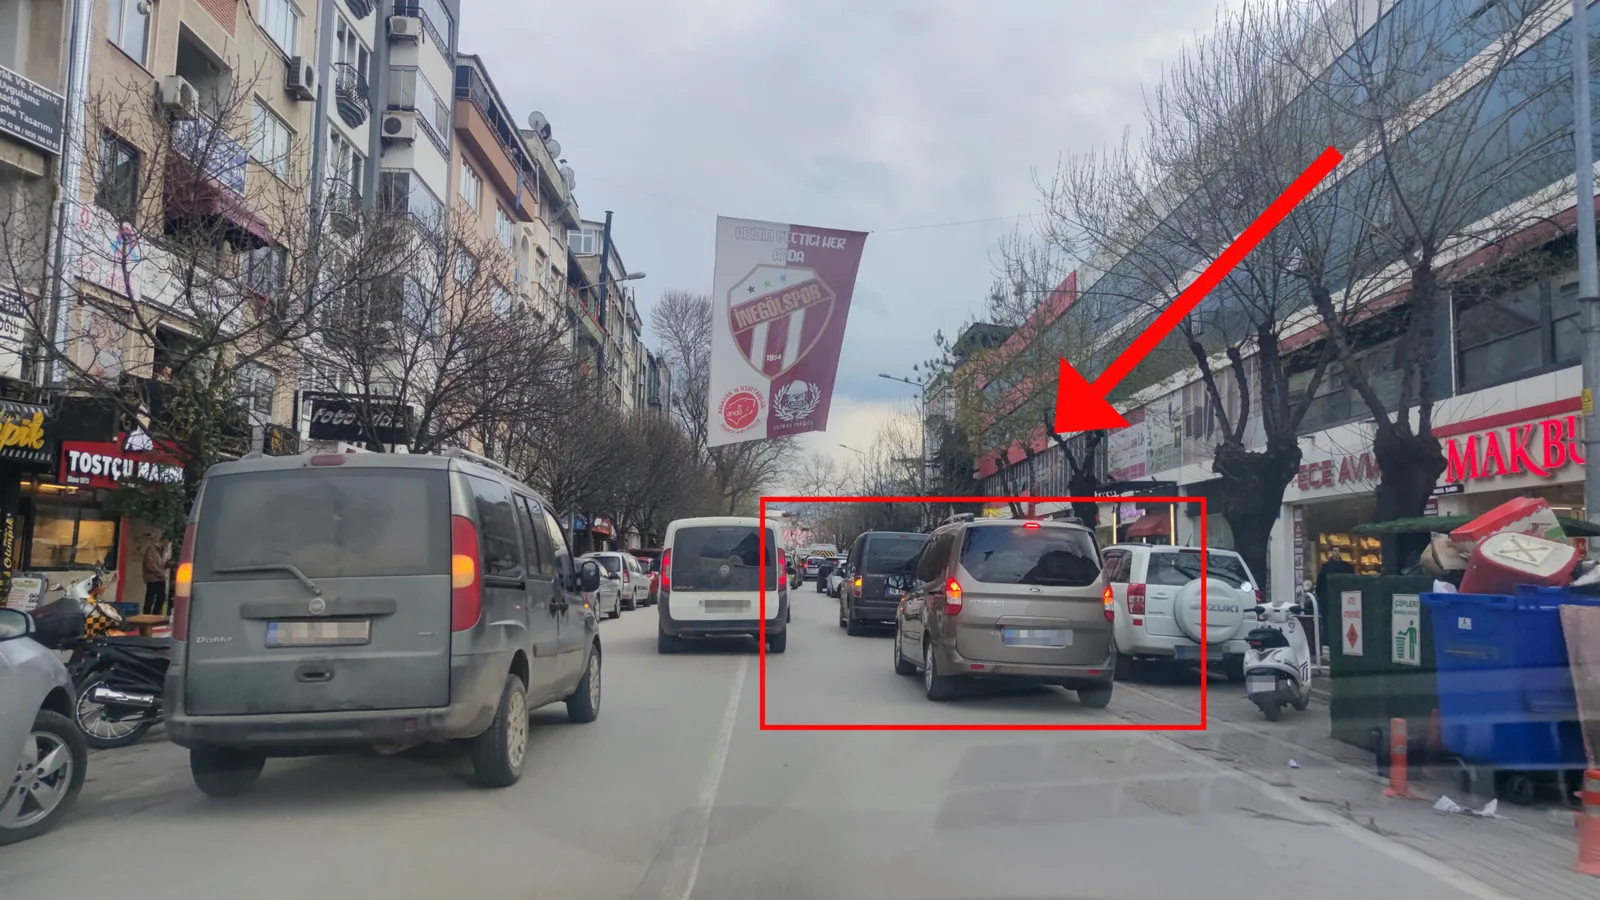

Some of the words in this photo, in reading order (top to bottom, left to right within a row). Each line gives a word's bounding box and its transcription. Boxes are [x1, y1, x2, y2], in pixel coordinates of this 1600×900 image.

[14, 76, 26, 88] Ve
[18, 110, 53, 134] Tasarımı
[821, 237, 847, 250] HER
[766, 353, 782, 361] 1954
[69, 450, 134, 481] TOSTÇU
[1297, 459, 1334, 491] ECE
